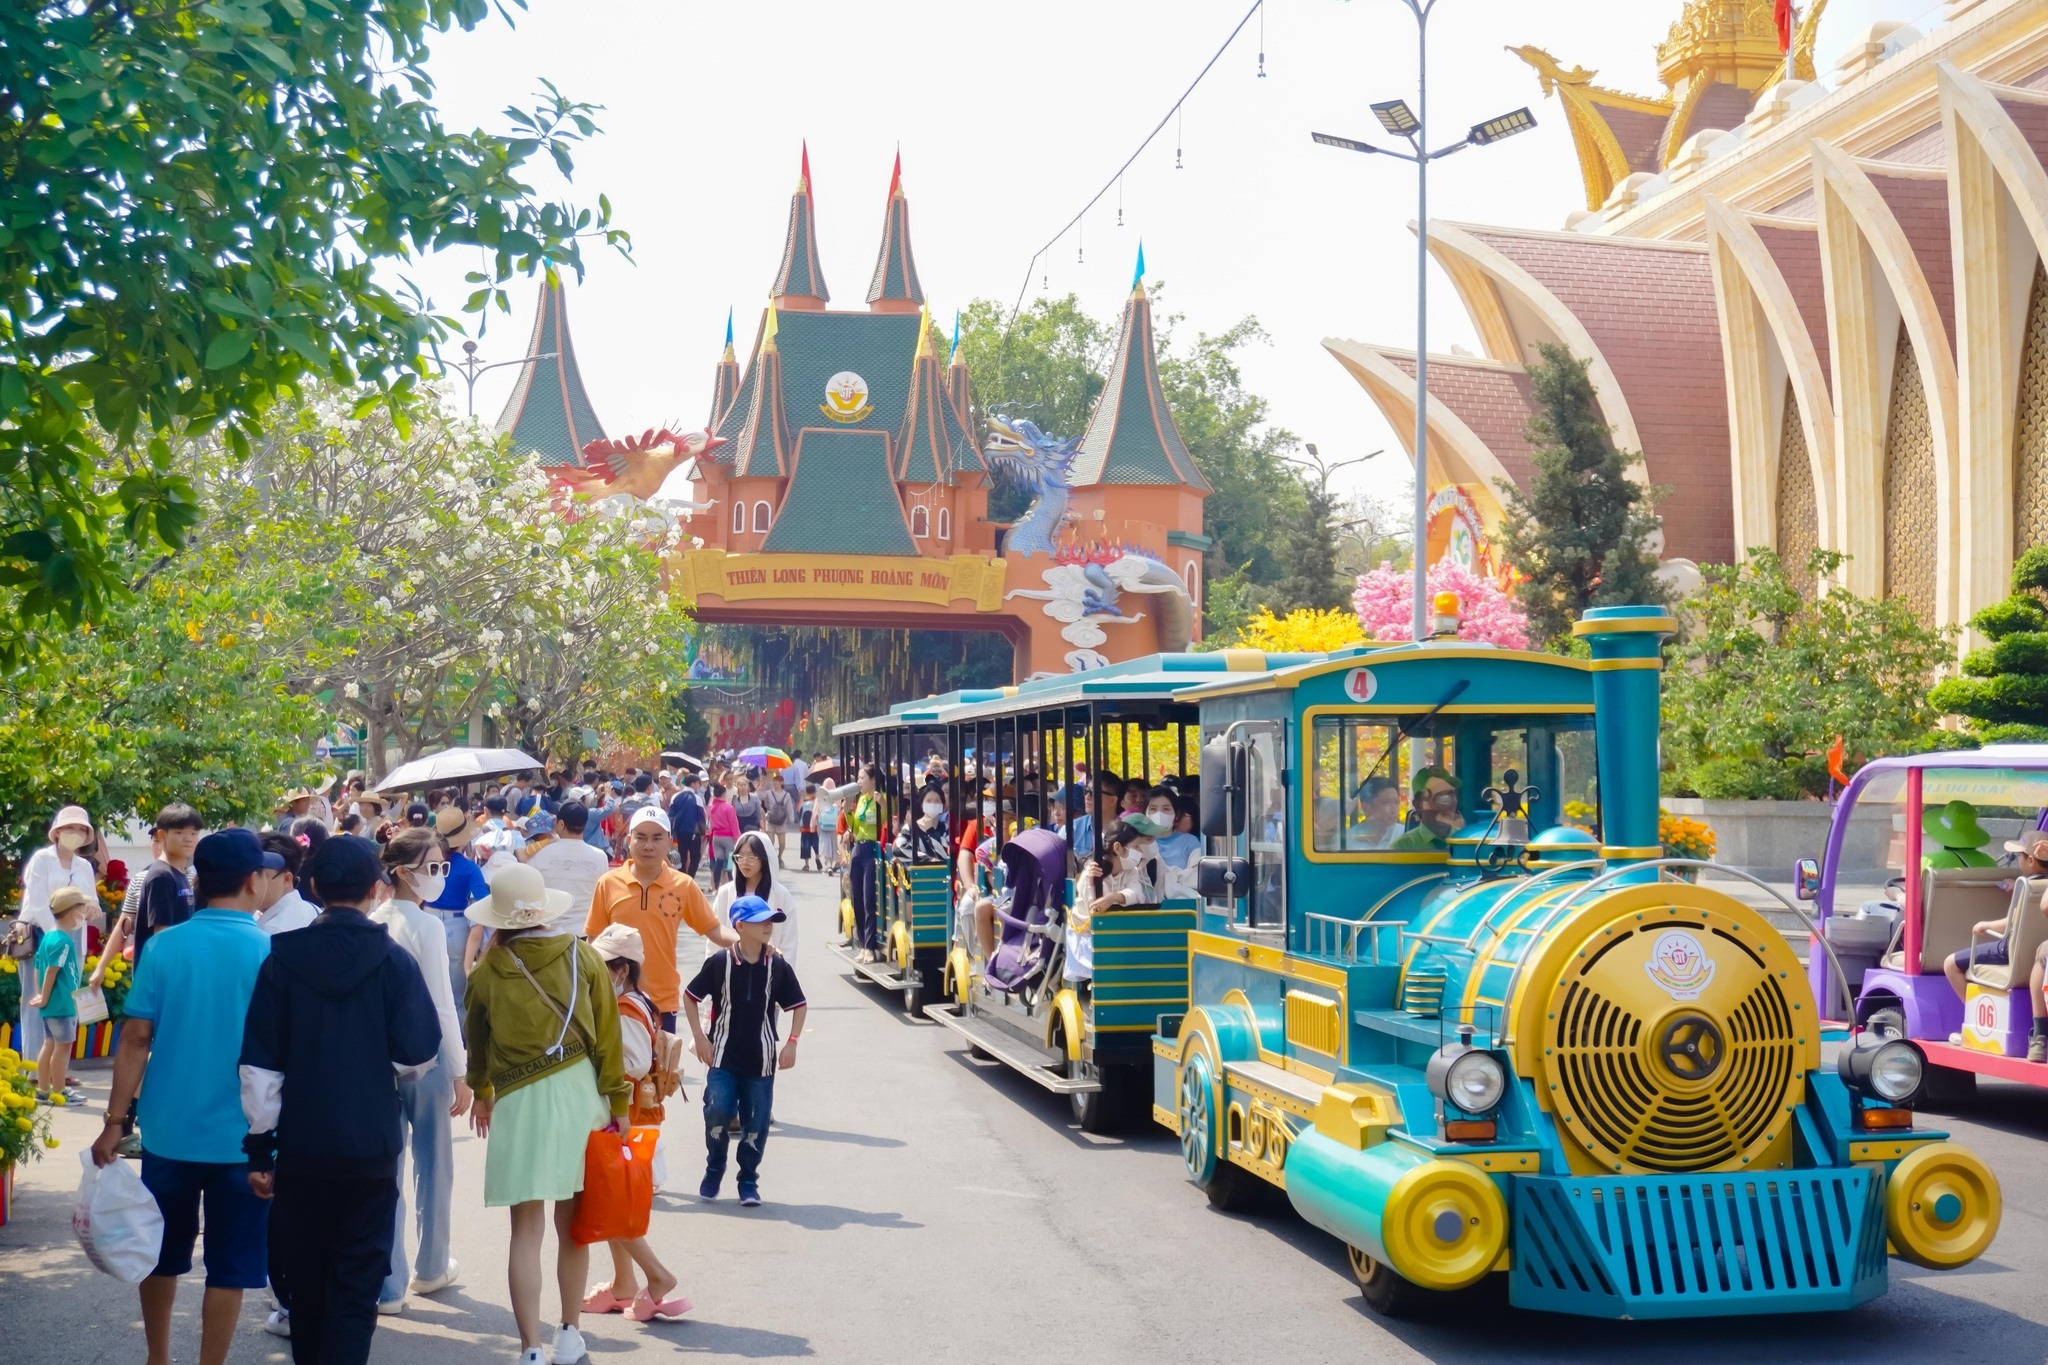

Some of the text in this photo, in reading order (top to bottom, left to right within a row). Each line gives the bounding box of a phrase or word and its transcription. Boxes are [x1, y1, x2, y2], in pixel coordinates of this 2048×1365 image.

[726, 567, 766, 586] THIÊN
[773, 569, 806, 584] LONG
[870, 569, 914, 586] HOÀNG
[920, 573, 950, 591] MÔN
[1353, 671, 1369, 698] 4
[1979, 1003, 1994, 1028] 06
[525, 1043, 585, 1074] CALIFORNIA
